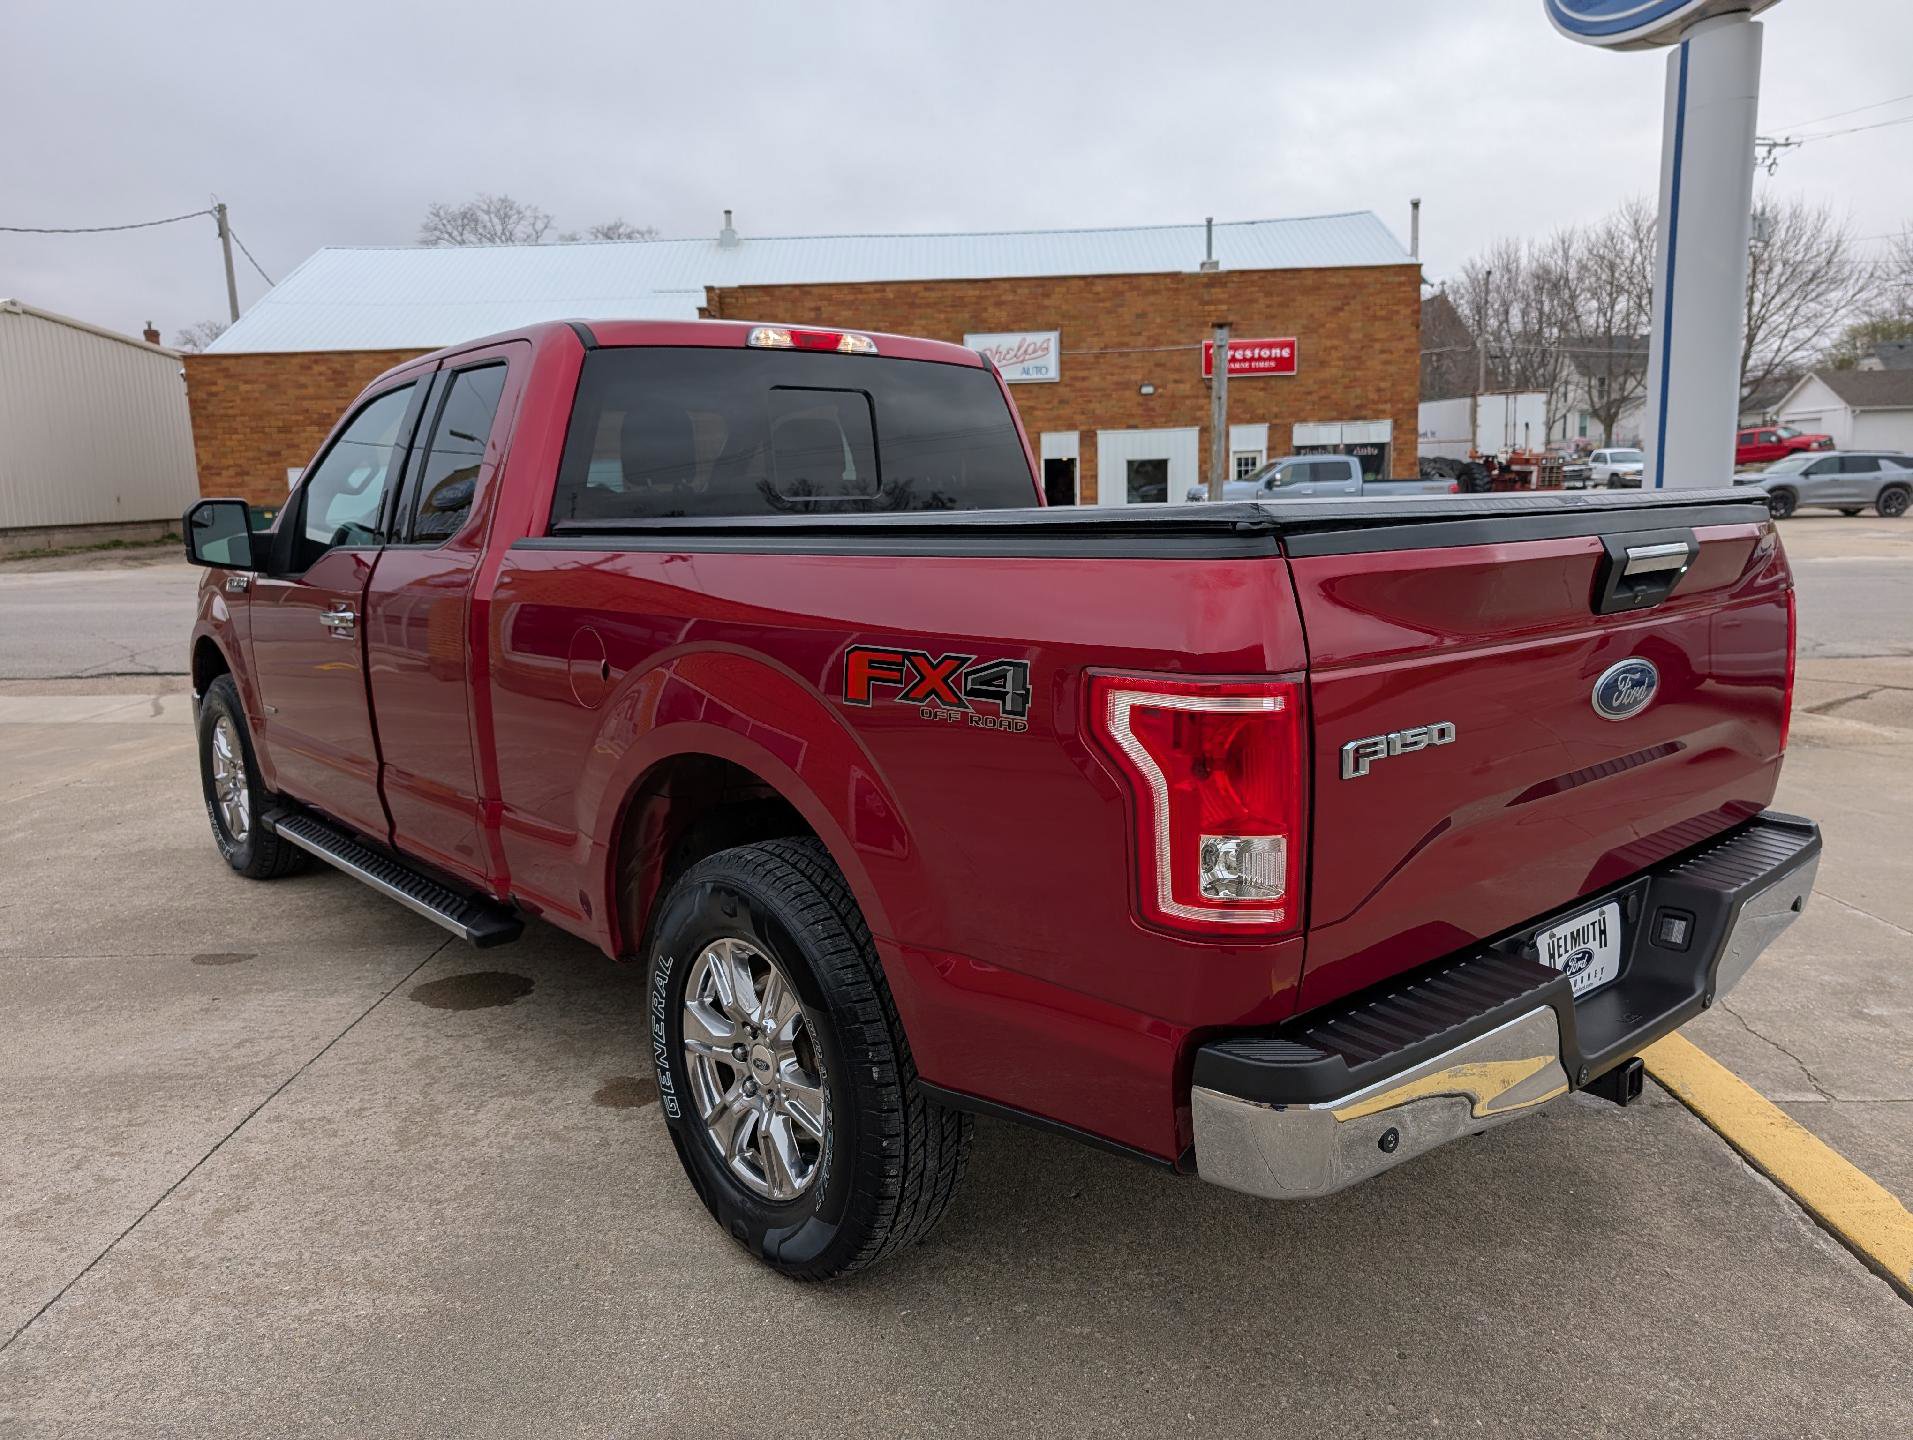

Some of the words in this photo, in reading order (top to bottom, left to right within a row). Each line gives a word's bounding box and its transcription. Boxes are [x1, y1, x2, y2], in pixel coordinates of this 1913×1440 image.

[1209, 347, 1291, 359] restone
[1021, 366, 1049, 376] AUTO
[843, 644, 1032, 720] FX4
[1612, 672, 1648, 707] Ford
[920, 706, 961, 723] OFF
[968, 712, 1029, 733] ROAD
[1547, 916, 1608, 969] HELMUTH
[1566, 951, 1590, 976] Ford
[651, 956, 681, 1119] GENERAL
